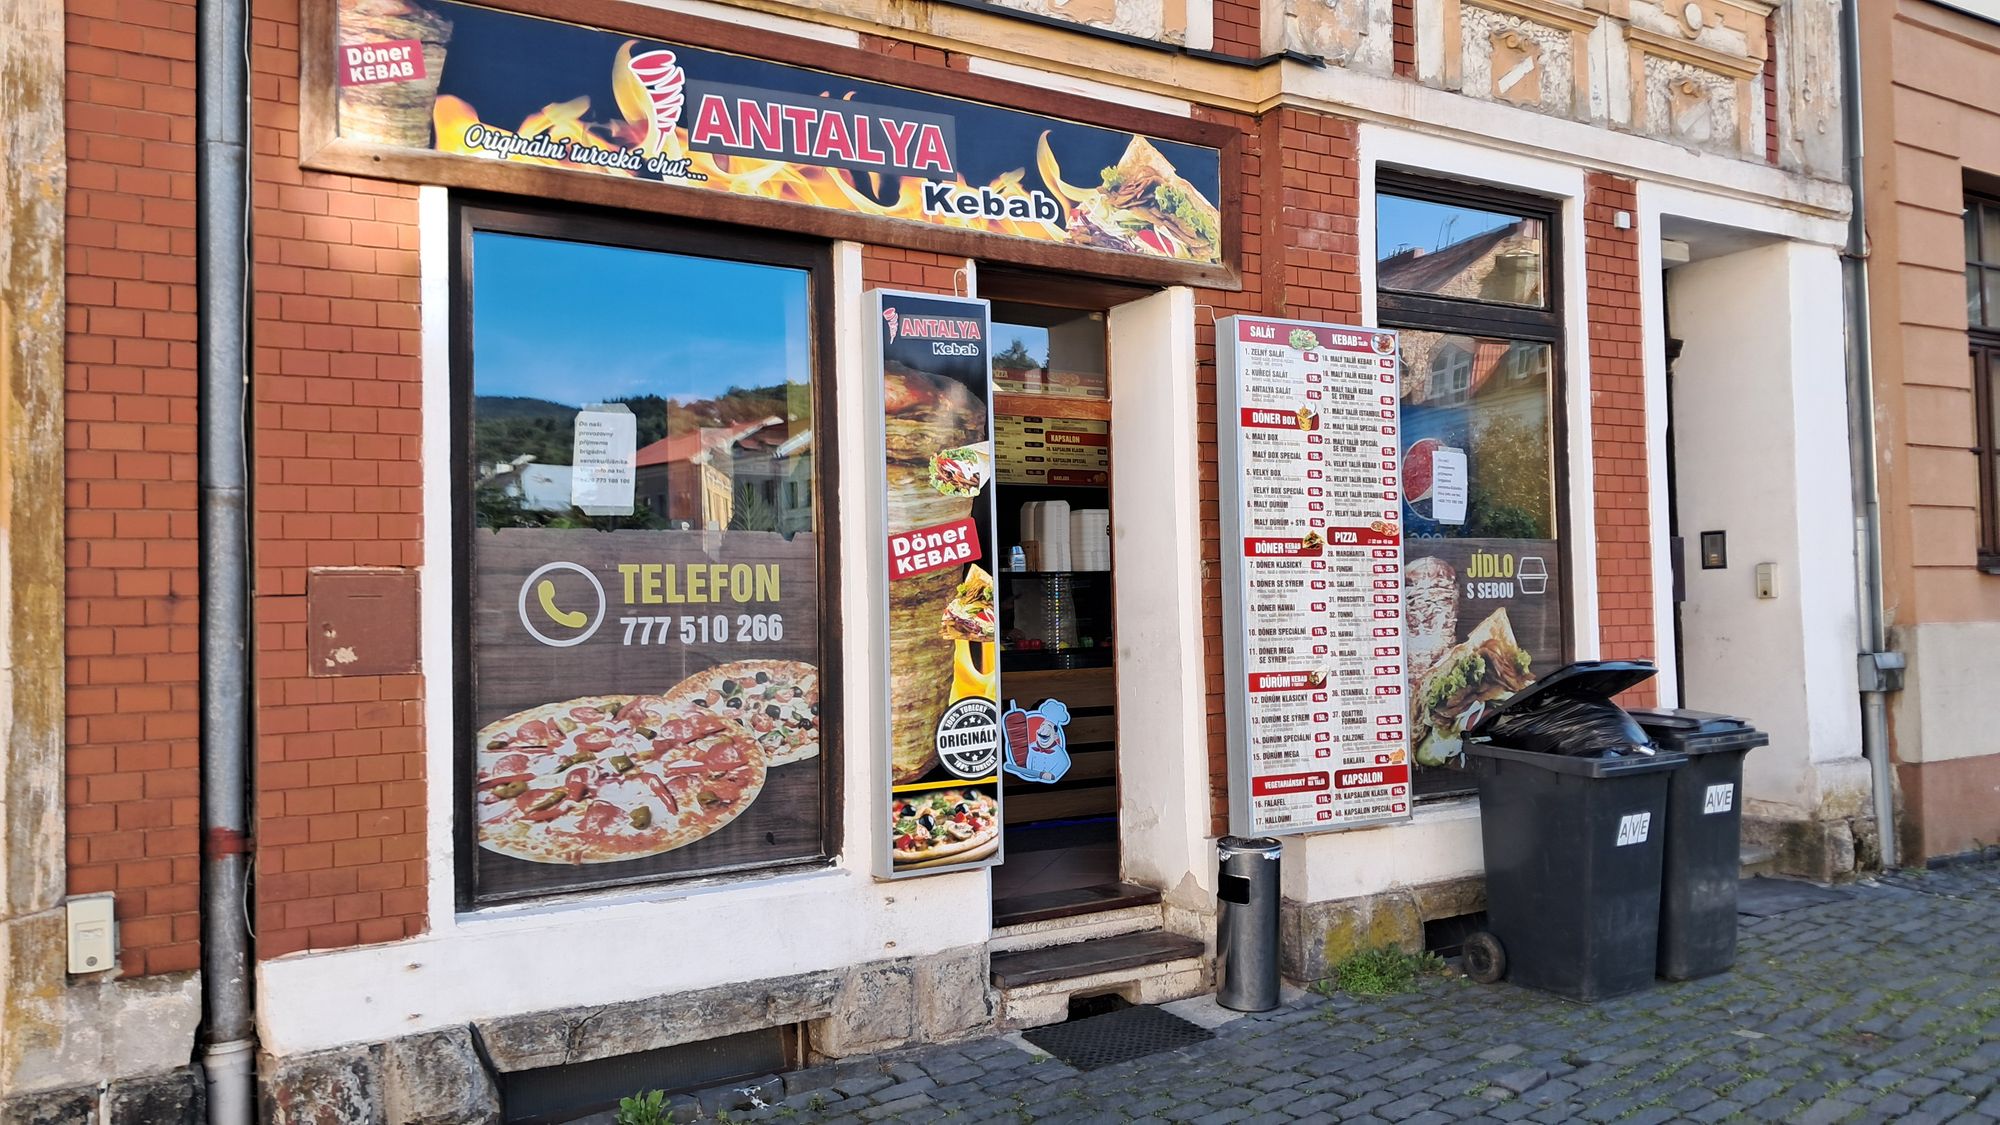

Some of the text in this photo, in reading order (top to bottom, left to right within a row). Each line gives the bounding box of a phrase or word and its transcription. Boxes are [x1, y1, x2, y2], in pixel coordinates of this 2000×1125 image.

[347, 45, 411, 65] Döner
[351, 61, 414, 83] KEBAB
[691, 94, 954, 174] ANTALYA
[464, 123, 566, 159] Originální
[570, 145, 642, 170] turecká
[922, 181, 1061, 222] Kebab
[900, 318, 981, 339] ANTALYA
[1250, 325, 1275, 339] SALÁT
[1332, 334, 1358, 346] KEBAB
[933, 342, 979, 355] Kebab
[1269, 349, 1284, 357] SALÁT
[1252, 368, 1288, 378] KUŘECÍ SALÁT
[1252, 385, 1291, 394] ANTALYA SALÁT
[1253, 410, 1296, 425] DÖNER BOX
[1050, 435, 1080, 443] KAPSALON
[1252, 432, 1266, 440] MALÝ
[1253, 450, 1266, 458] MALÝ
[1280, 451, 1301, 460] SPECIÁL
[1253, 468, 1269, 476] VELKÝ
[1253, 486, 1270, 494] VELKÝ
[1283, 487, 1304, 495] SPECIÁL
[1254, 500, 1267, 508] MALÝ
[892, 526, 967, 557] Döner
[1335, 532, 1357, 543] PIZZA
[1255, 540, 1283, 553] DÖNER
[897, 542, 971, 574] KEBAB
[1256, 560, 1275, 568] DÖNER
[1276, 560, 1302, 568] KLASICKÝ
[1467, 549, 1513, 578] JÍDLO
[618, 564, 780, 604] TELEFON
[1285, 579, 1304, 587] SÝREM
[1467, 582, 1514, 599] S SEBOU
[1258, 602, 1276, 611] DÖNER
[620, 614, 783, 646] 777 510 266
[1258, 627, 1276, 635] DÖNER
[1278, 627, 1306, 635] SPECIÁLNÍ
[1259, 646, 1277, 655] DÖNER
[1268, 655, 1287, 663] SÝREM
[1260, 674, 1290, 688] DÜRÜM
[1261, 694, 1281, 703] DÜRÜM
[1282, 692, 1308, 702] KLASICKÝ
[1262, 714, 1281, 723] DÜRÜM
[1292, 713, 1310, 722] SÝREM
[1342, 717, 1367, 725] FORMAGGI
[1284, 734, 1311, 742] SPECIÁLNÍ
[1343, 757, 1365, 765] BAKLAVA
[1342, 771, 1383, 786] KAPSALON
[1344, 789, 1388, 799] KAPSALON KLASIK
[1706, 789, 1731, 807] AVE
[1265, 799, 1286, 807] FALAFEL
[1344, 807, 1370, 816] KAPSALON
[1265, 815, 1291, 824] HALLOUMI
[1619, 819, 1649, 838] AVE
